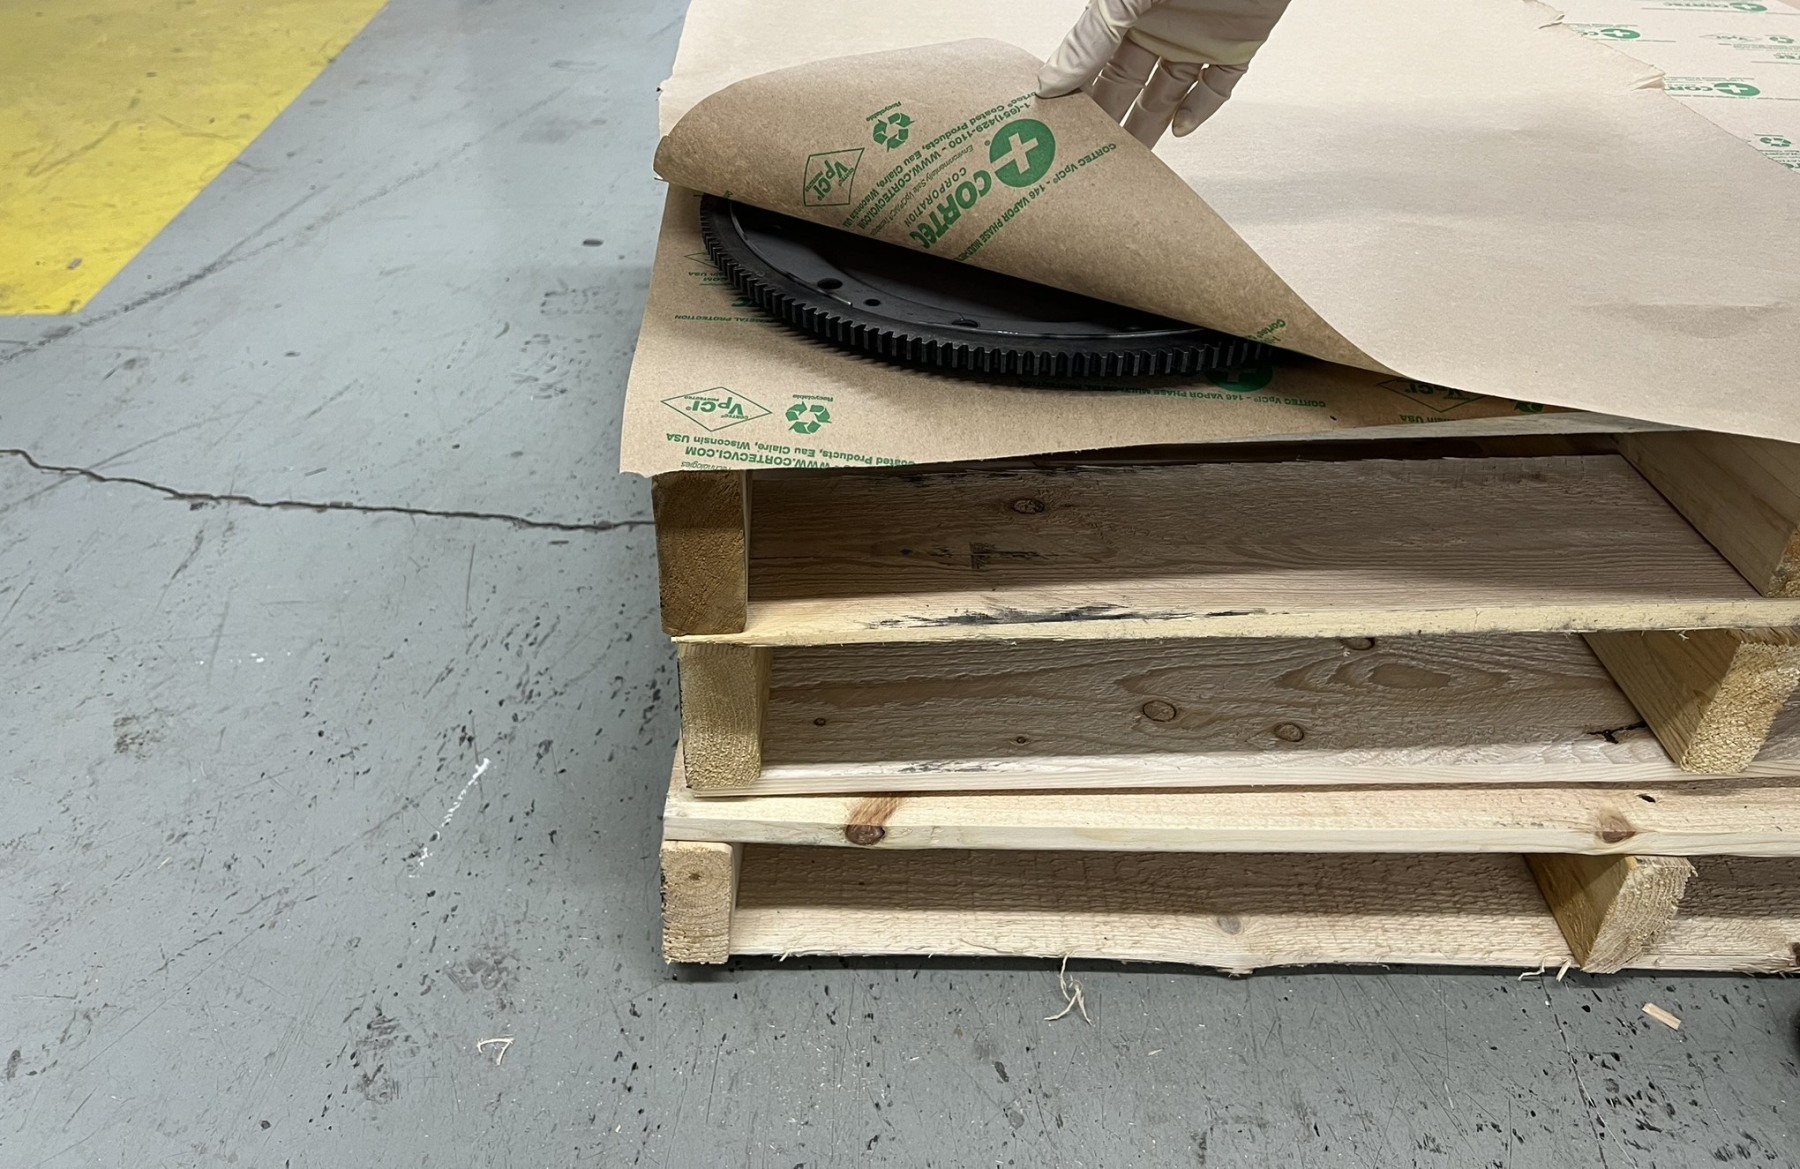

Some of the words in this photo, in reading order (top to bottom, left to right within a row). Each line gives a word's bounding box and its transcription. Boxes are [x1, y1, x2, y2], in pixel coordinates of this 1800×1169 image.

[1008, 91, 1036, 108] ortec®
[866, 101, 902, 122] Recyclable
[969, 105, 1005, 126] Coated
[948, 102, 1031, 149] 1-(651)429-1100
[922, 122, 969, 150] Products,
[903, 150, 922, 166] Eau
[926, 144, 974, 183] Environmentally
[1078, 143, 1117, 166] CORTEC
[876, 165, 904, 188] Claire,
[857, 150, 942, 230] WWW.CORTECVCI.COM
[903, 167, 967, 228] CORPORATION
[1028, 184, 1046, 200] 146
[849, 188, 880, 220] Wisconsin
[909, 169, 993, 249] CORTEC
[1002, 196, 1031, 222] VAPOR
[979, 217, 1005, 244] PHASE
[674, 314, 732, 322] PROTECTION
[793, 394, 834, 402] Recyclable
[1154, 389, 1187, 398] PHASE
[1189, 392, 1223, 400] VAPOR
[1285, 399, 1326, 408] CORTEC
[666, 433, 690, 443] USA
[694, 436, 750, 451] Wisconsin
[755, 442, 790, 455] Claire,
[794, 447, 815, 458] Eau
[820, 449, 872, 465] Products,
